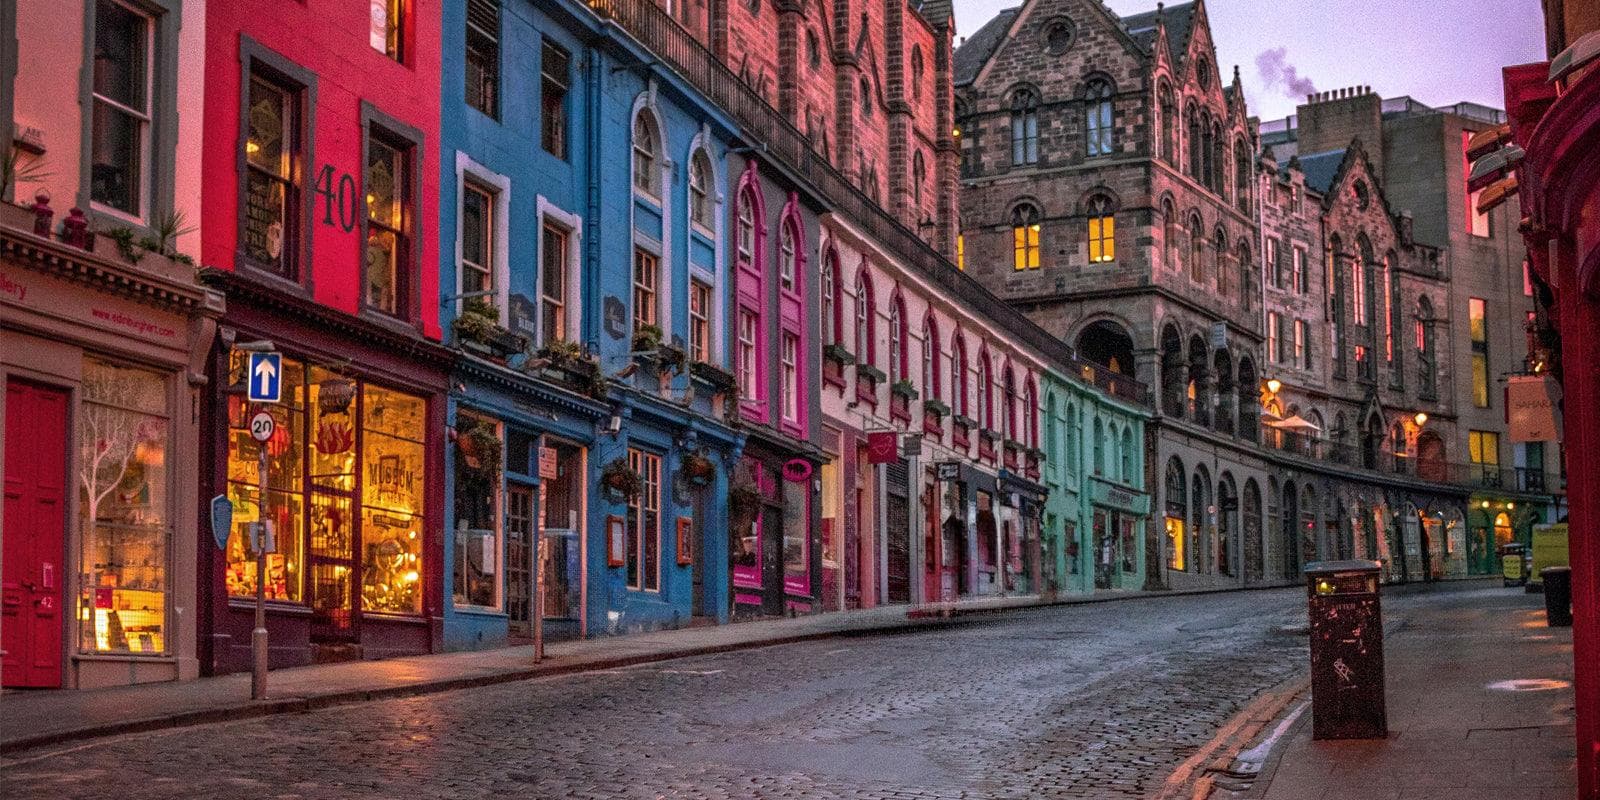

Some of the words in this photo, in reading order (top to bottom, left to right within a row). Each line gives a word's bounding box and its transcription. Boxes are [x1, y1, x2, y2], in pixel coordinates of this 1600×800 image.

[313, 163, 356, 233] 40
[253, 420, 272, 434] 20
[41, 596, 54, 608] 42
